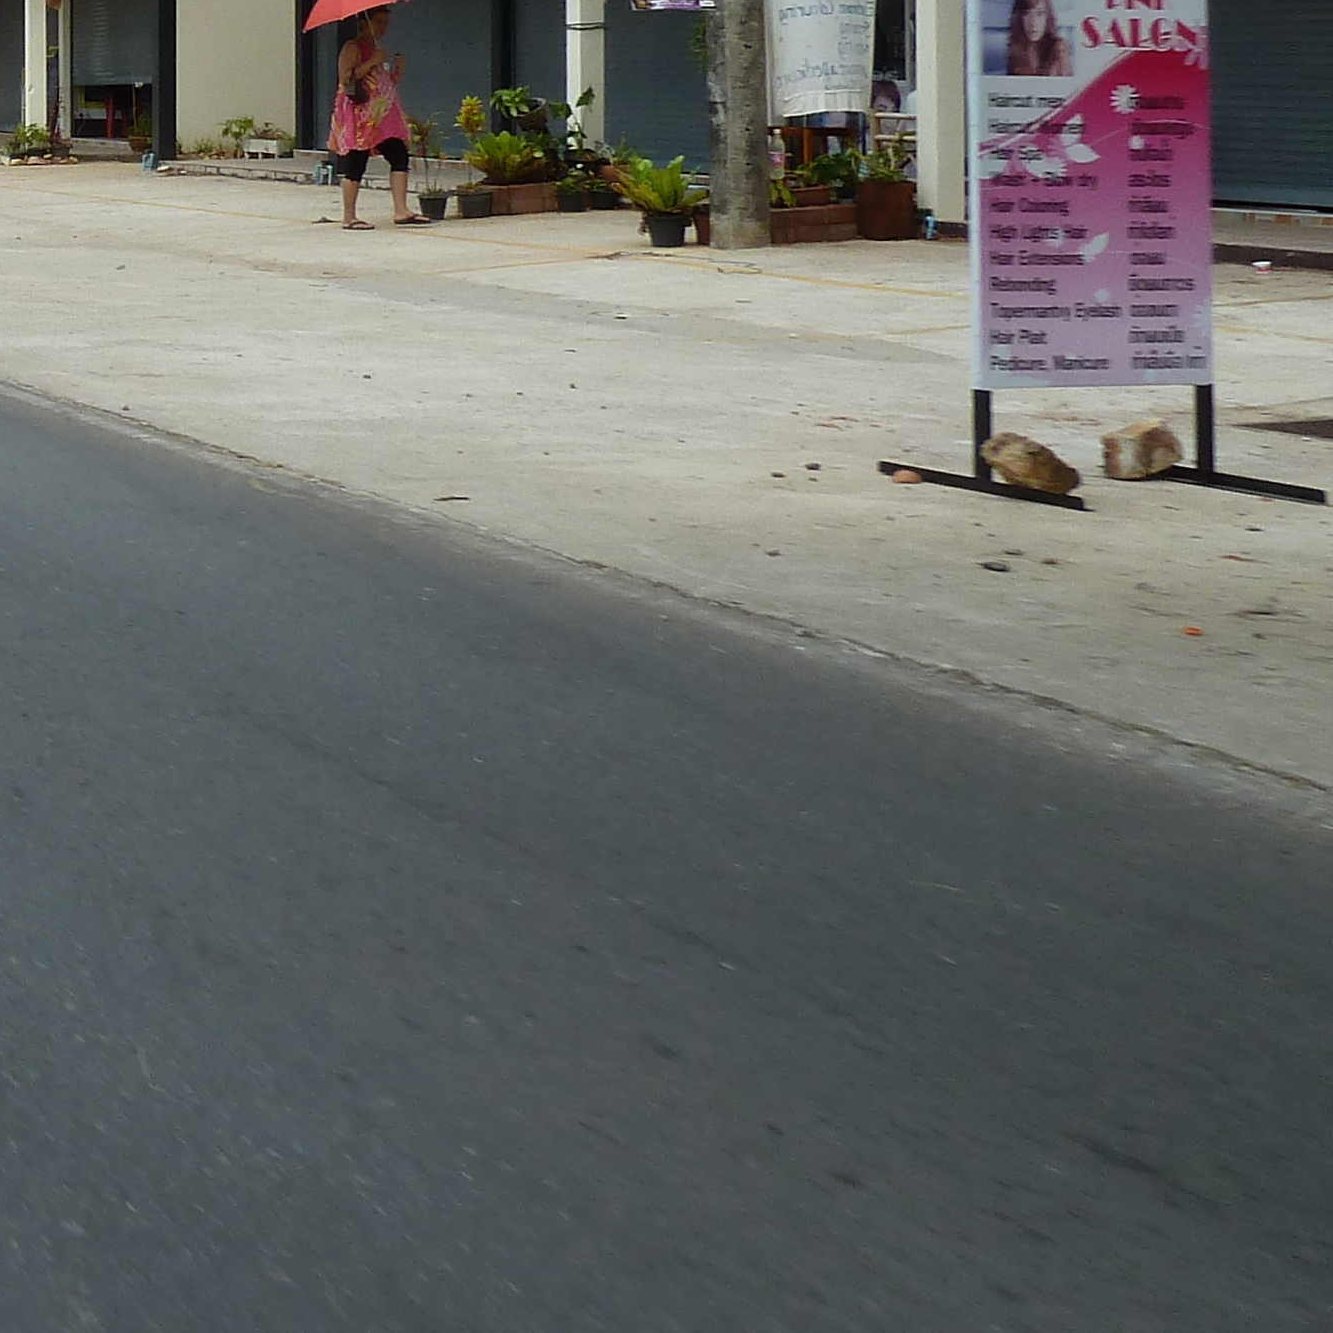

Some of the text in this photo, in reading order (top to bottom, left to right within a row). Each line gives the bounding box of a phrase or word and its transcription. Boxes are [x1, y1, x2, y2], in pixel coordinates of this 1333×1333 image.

[1082, 16, 1202, 49] SALON
[988, 92, 1032, 108] Haircut
[989, 198, 1015, 213] Hair
[989, 224, 1018, 243] High
[1063, 224, 1089, 239] Hair
[989, 249, 1085, 265] Hair Extensions
[989, 276, 1058, 295] Rebonding
[1074, 302, 1124, 322] Eyelash
[989, 330, 1015, 345] Hair
[1052, 355, 1113, 370] Manicure
